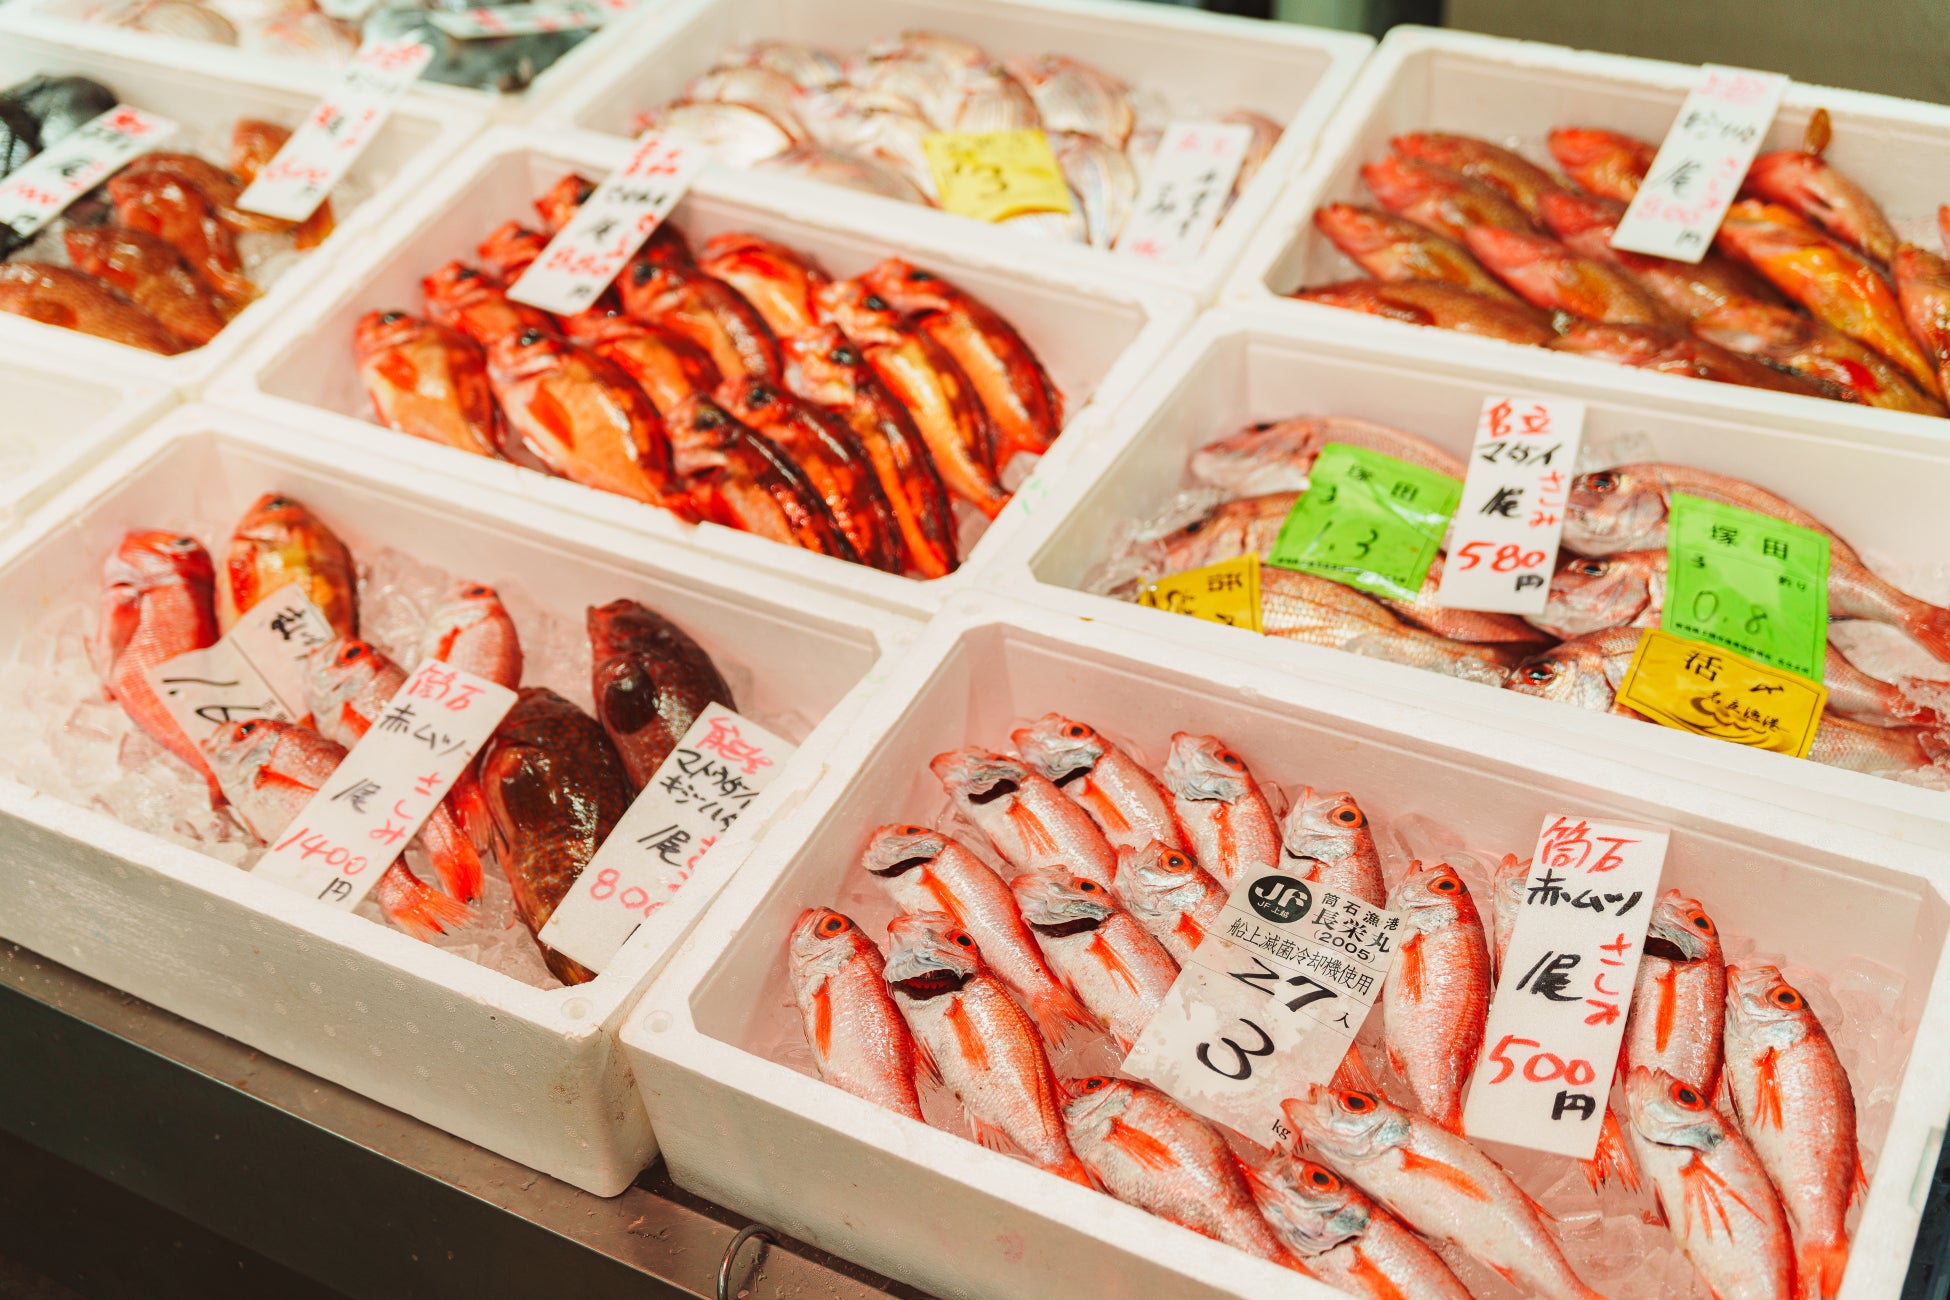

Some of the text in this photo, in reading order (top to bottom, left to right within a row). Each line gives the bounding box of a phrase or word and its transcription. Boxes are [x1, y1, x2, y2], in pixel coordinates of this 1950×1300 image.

[1528, 470, 1566, 528] さしみ
[1457, 541, 1547, 573] 580
[1711, 523, 1789, 561] 塚田
[1515, 574, 1545, 592] 円
[1692, 590, 1768, 637] 0.8
[406, 662, 486, 712] 筒石
[378, 703, 467, 757] 赤ムツ
[368, 771, 443, 845] さしみ
[274, 827, 368, 876] 1400
[1541, 816, 1642, 874] 筒石
[317, 877, 353, 902] 円
[1254, 882, 1308, 908] JF
[1321, 892, 1400, 931] 筒石漁港
[1527, 868, 1643, 916] 赤ムツ
[1311, 908, 1391, 953] 長栄丸
[1313, 930, 1376, 964] (2005)
[1227, 917, 1375, 997] 船上滅菌冷却機使用
[1583, 932, 1632, 1026] さしみ
[1196, 1018, 1275, 1081] 3
[1488, 1034, 1596, 1085] 500
[1551, 1090, 1597, 1121] 円
[1271, 1119, 1292, 1141] kg
